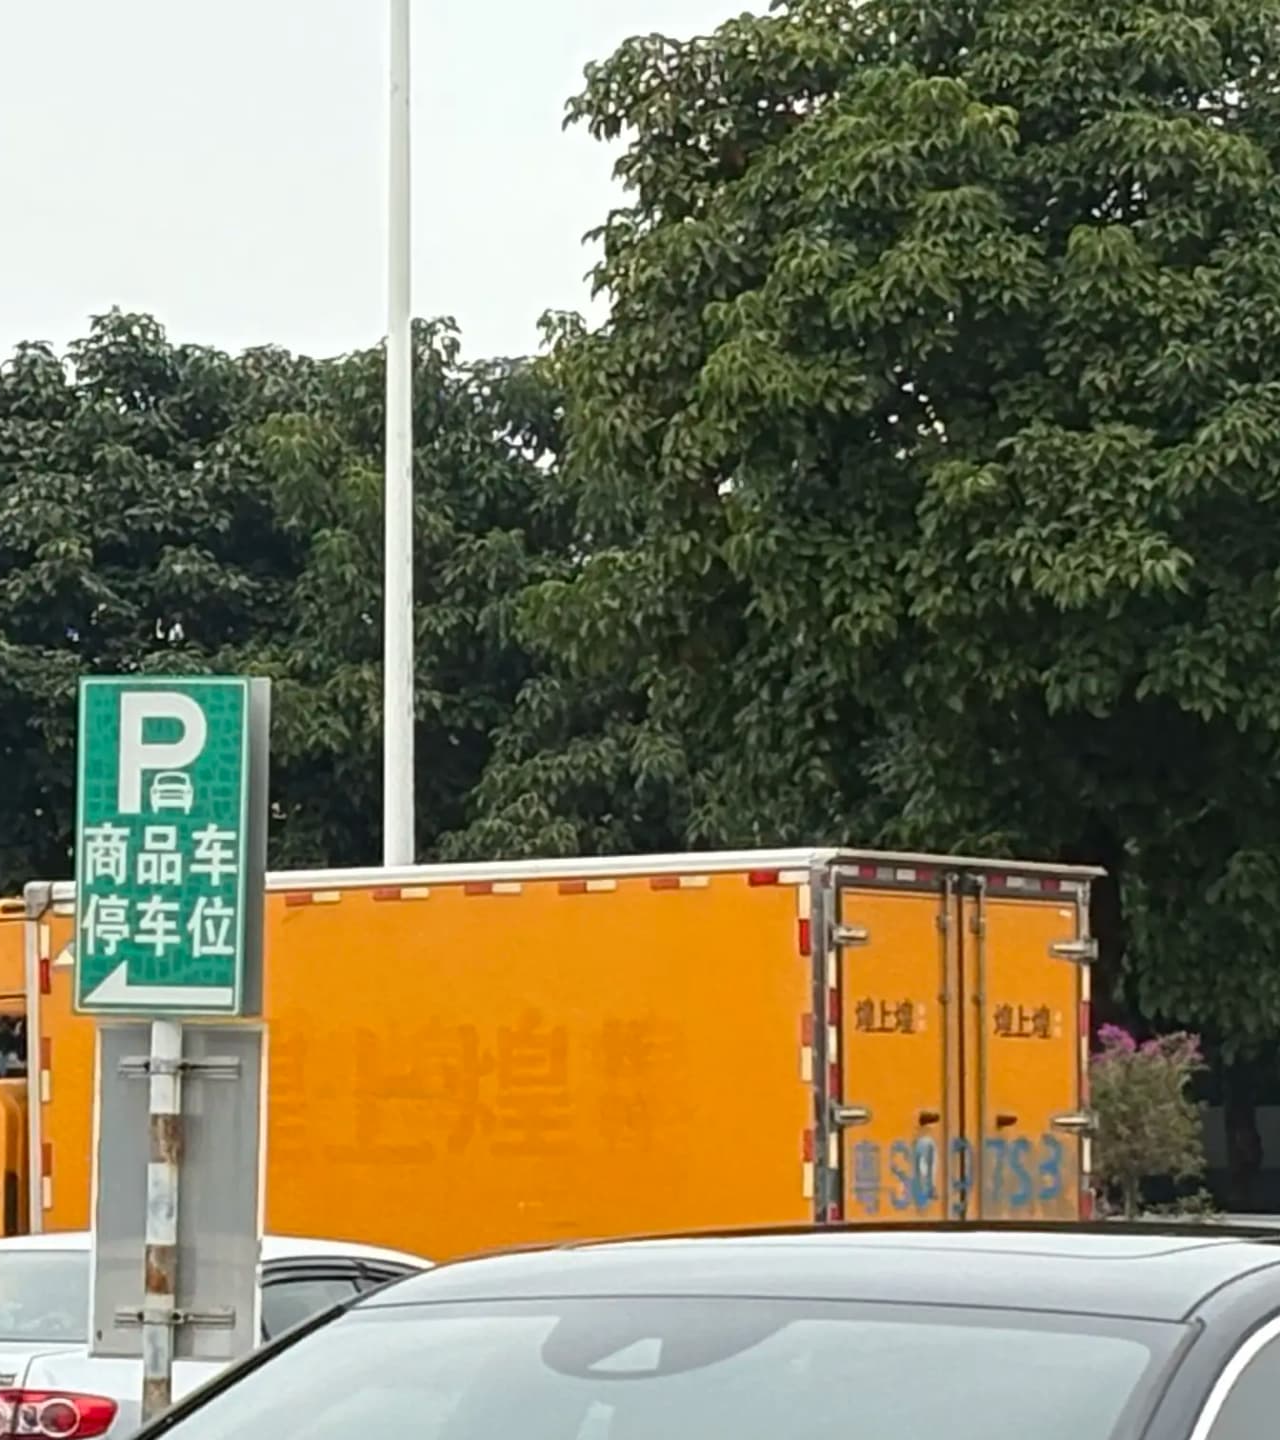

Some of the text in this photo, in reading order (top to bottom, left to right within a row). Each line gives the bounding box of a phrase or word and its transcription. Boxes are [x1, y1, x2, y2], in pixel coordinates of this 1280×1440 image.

[118, 691, 208, 814] P
[84, 822, 238, 886] 商品车
[82, 895, 235, 957] 停车位
